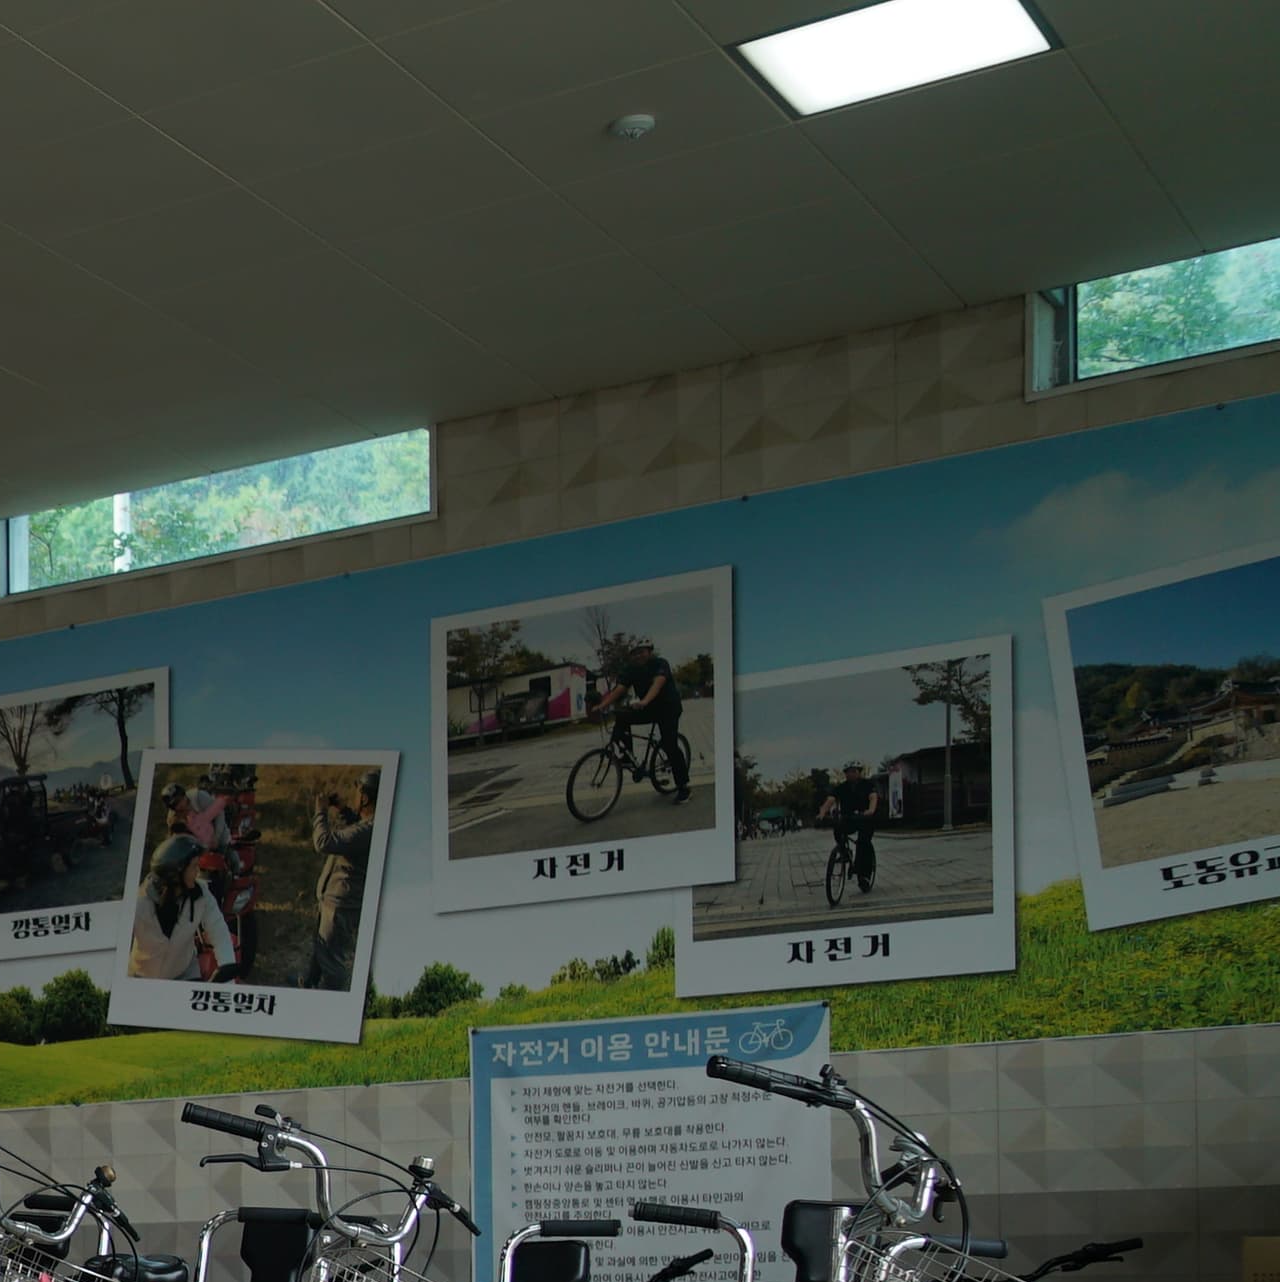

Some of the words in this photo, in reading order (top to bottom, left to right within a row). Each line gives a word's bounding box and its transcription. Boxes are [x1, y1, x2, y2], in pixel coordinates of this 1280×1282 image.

[533, 848, 625, 880] 자전거
[11, 911, 91, 940] 깡통열차
[786, 933, 891, 964] 자전거
[190, 987, 276, 1017] 깡통열차
[492, 1038, 570, 1067] 자전거
[581, 1030, 633, 1061] 이용
[645, 1026, 731, 1058] 안내문
[523, 1086, 540, 1097] 자기
[596, 1081, 634, 1094] 자전거를
[523, 1103, 559, 1114] 자전거의
[644, 1124, 682, 1137] 보호대를
[524, 1149, 552, 1160] 자전거
[555, 1147, 581, 1158] 도로로
[584, 1146, 602, 1157] 이동
[606, 1145, 615, 1156] 및
[722, 1138, 752, 1150] 나가지
[755, 1136, 790, 1149] 않는다.
[565, 1163, 582, 1175] 쉬운
[680, 1158, 708, 1170] 신발을
[712, 1157, 731, 1169] 신고
[735, 1155, 756, 1167] 타지
[759, 1153, 792, 1166] 않는다.
[524, 1181, 560, 1193] 한손이나
[564, 1180, 592, 1192] 양손을
[616, 1179, 635, 1190] 타지
[606, 1196, 624, 1208] 센터
[670, 1192, 699, 1205] 이용시
[702, 1191, 743, 1204] 타인과의
[627, 1225, 655, 1237] 이용시
[639, 1255, 657, 1266] 의한
